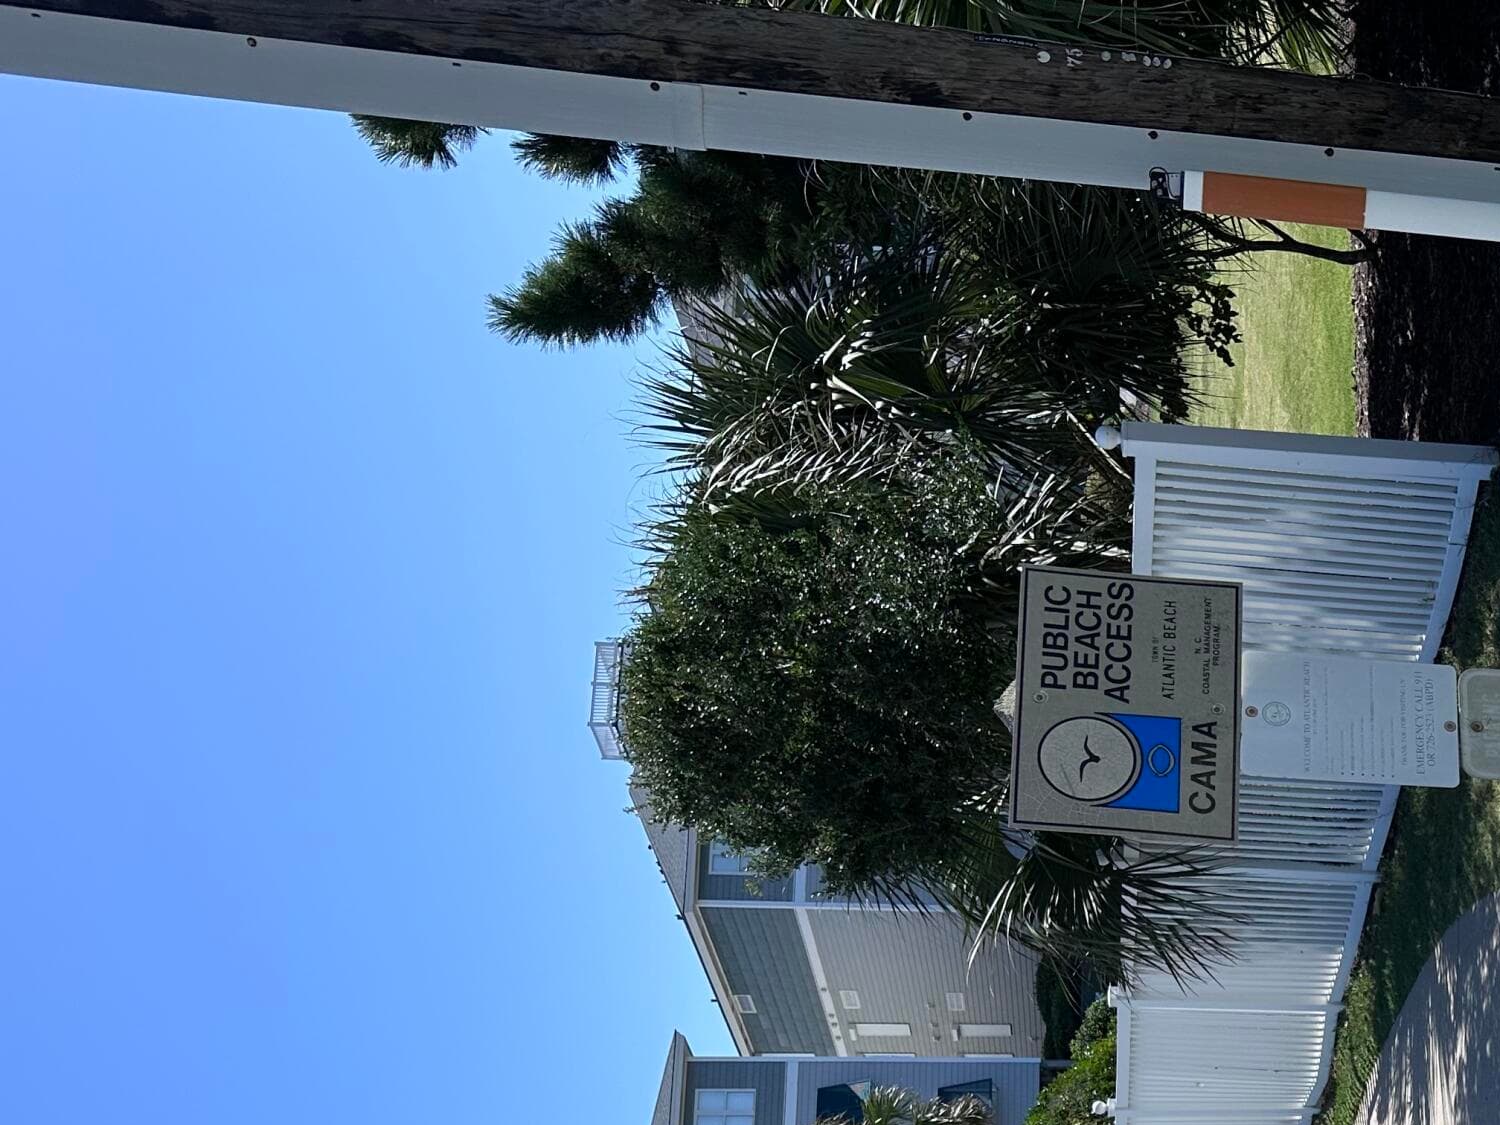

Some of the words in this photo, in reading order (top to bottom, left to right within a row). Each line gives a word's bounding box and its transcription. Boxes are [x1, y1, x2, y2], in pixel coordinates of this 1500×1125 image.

[1065, 48, 1083, 67] 75
[1040, 585, 1071, 690] PUBLIC
[1163, 600, 1177, 639] BEACH
[1203, 597, 1212, 655] MANAGEMENT
[1072, 590, 1102, 690] BEACH
[1104, 581, 1134, 704] ACCESS
[1161, 645, 1176, 700] ATLANTIC
[1202, 658, 1210, 695] COASTAL
[1413, 671, 1423, 685] 911
[1303, 688, 1311, 721] ATLANTIC
[1414, 687, 1424, 712] CALL
[1303, 723, 1311, 733] TO
[1415, 714, 1425, 775] EMERGENCY
[1189, 721, 1218, 815] CAMA
[1427, 753, 1436, 767] OR
